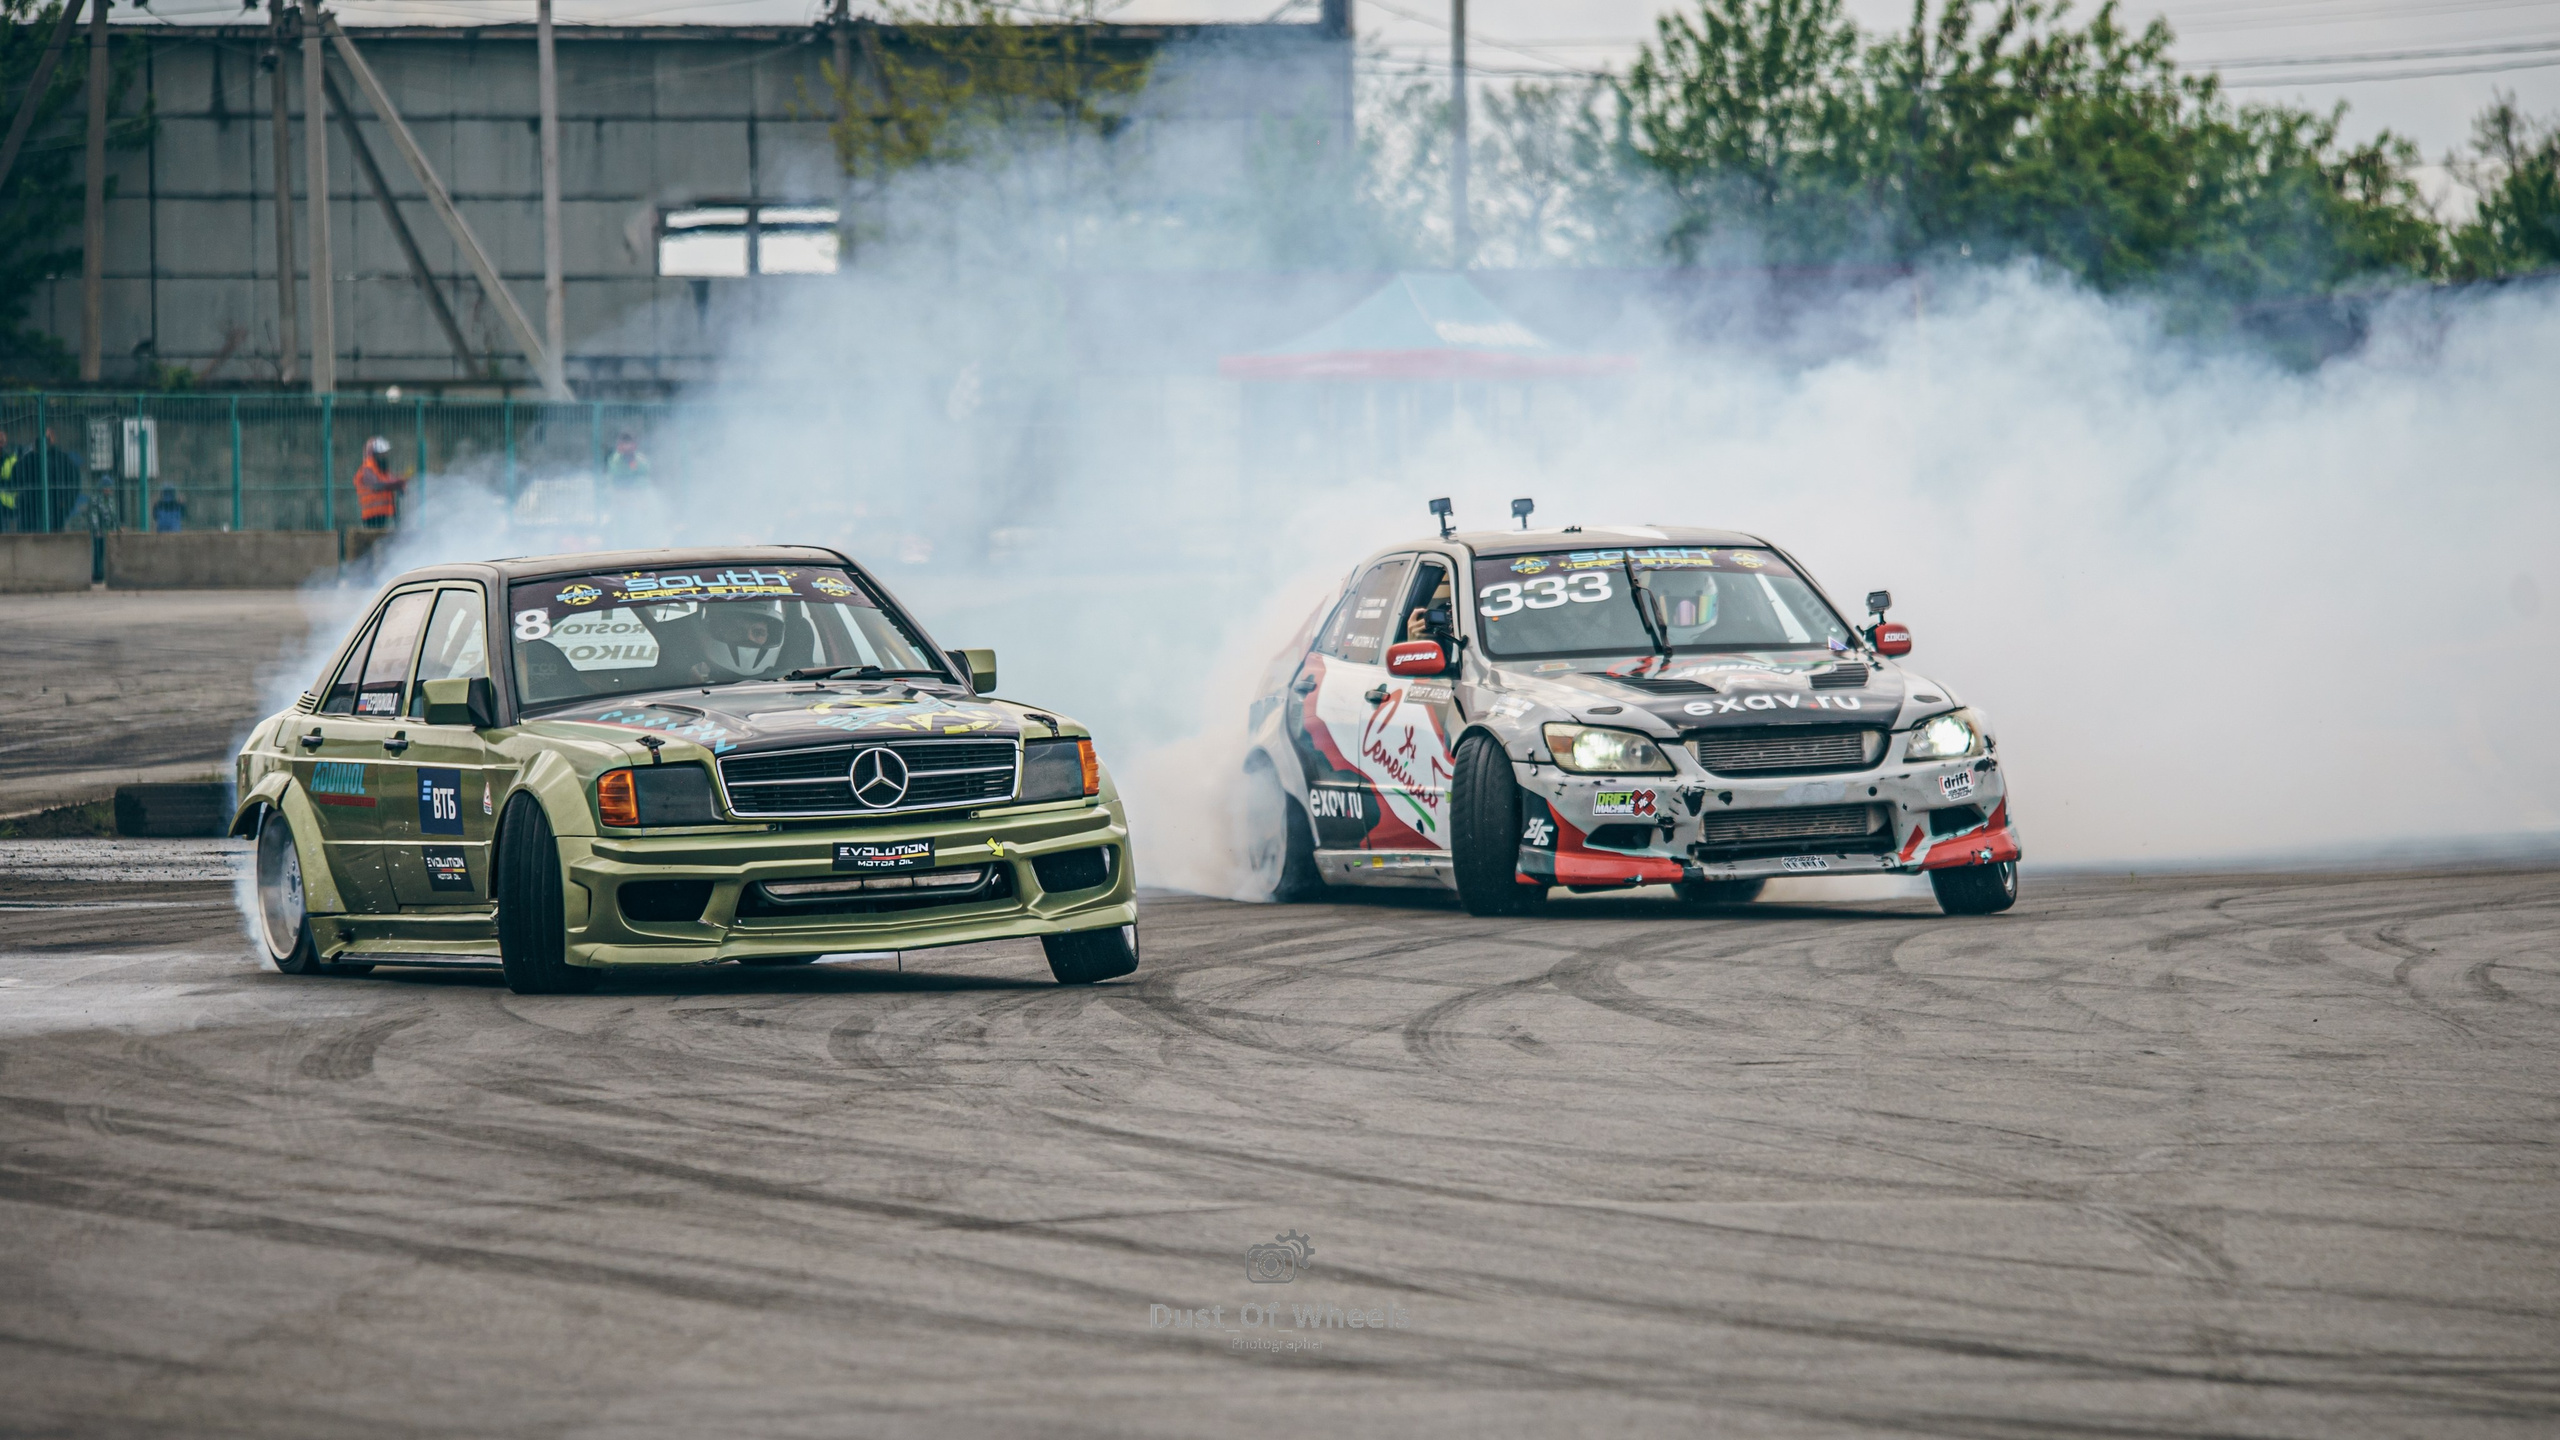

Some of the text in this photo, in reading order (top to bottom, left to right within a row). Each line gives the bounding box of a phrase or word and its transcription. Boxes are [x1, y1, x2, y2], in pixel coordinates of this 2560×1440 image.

[629, 585, 794, 600] DRIFT STARS
[1480, 572, 1612, 618] 333
[515, 609, 550, 640] 8
[1683, 693, 1861, 716] exav.ru
[597, 710, 738, 754] ADDINOL
[310, 761, 366, 795] ADDINOL
[433, 788, 457, 820] ВТБ
[1309, 789, 1363, 820] exav.ru
[1595, 804, 1634, 814] MACHINE
[1597, 793, 1633, 805] DRIFT
[427, 857, 465, 868] EVOLUTION
[839, 842, 929, 857] EVOLUTION
